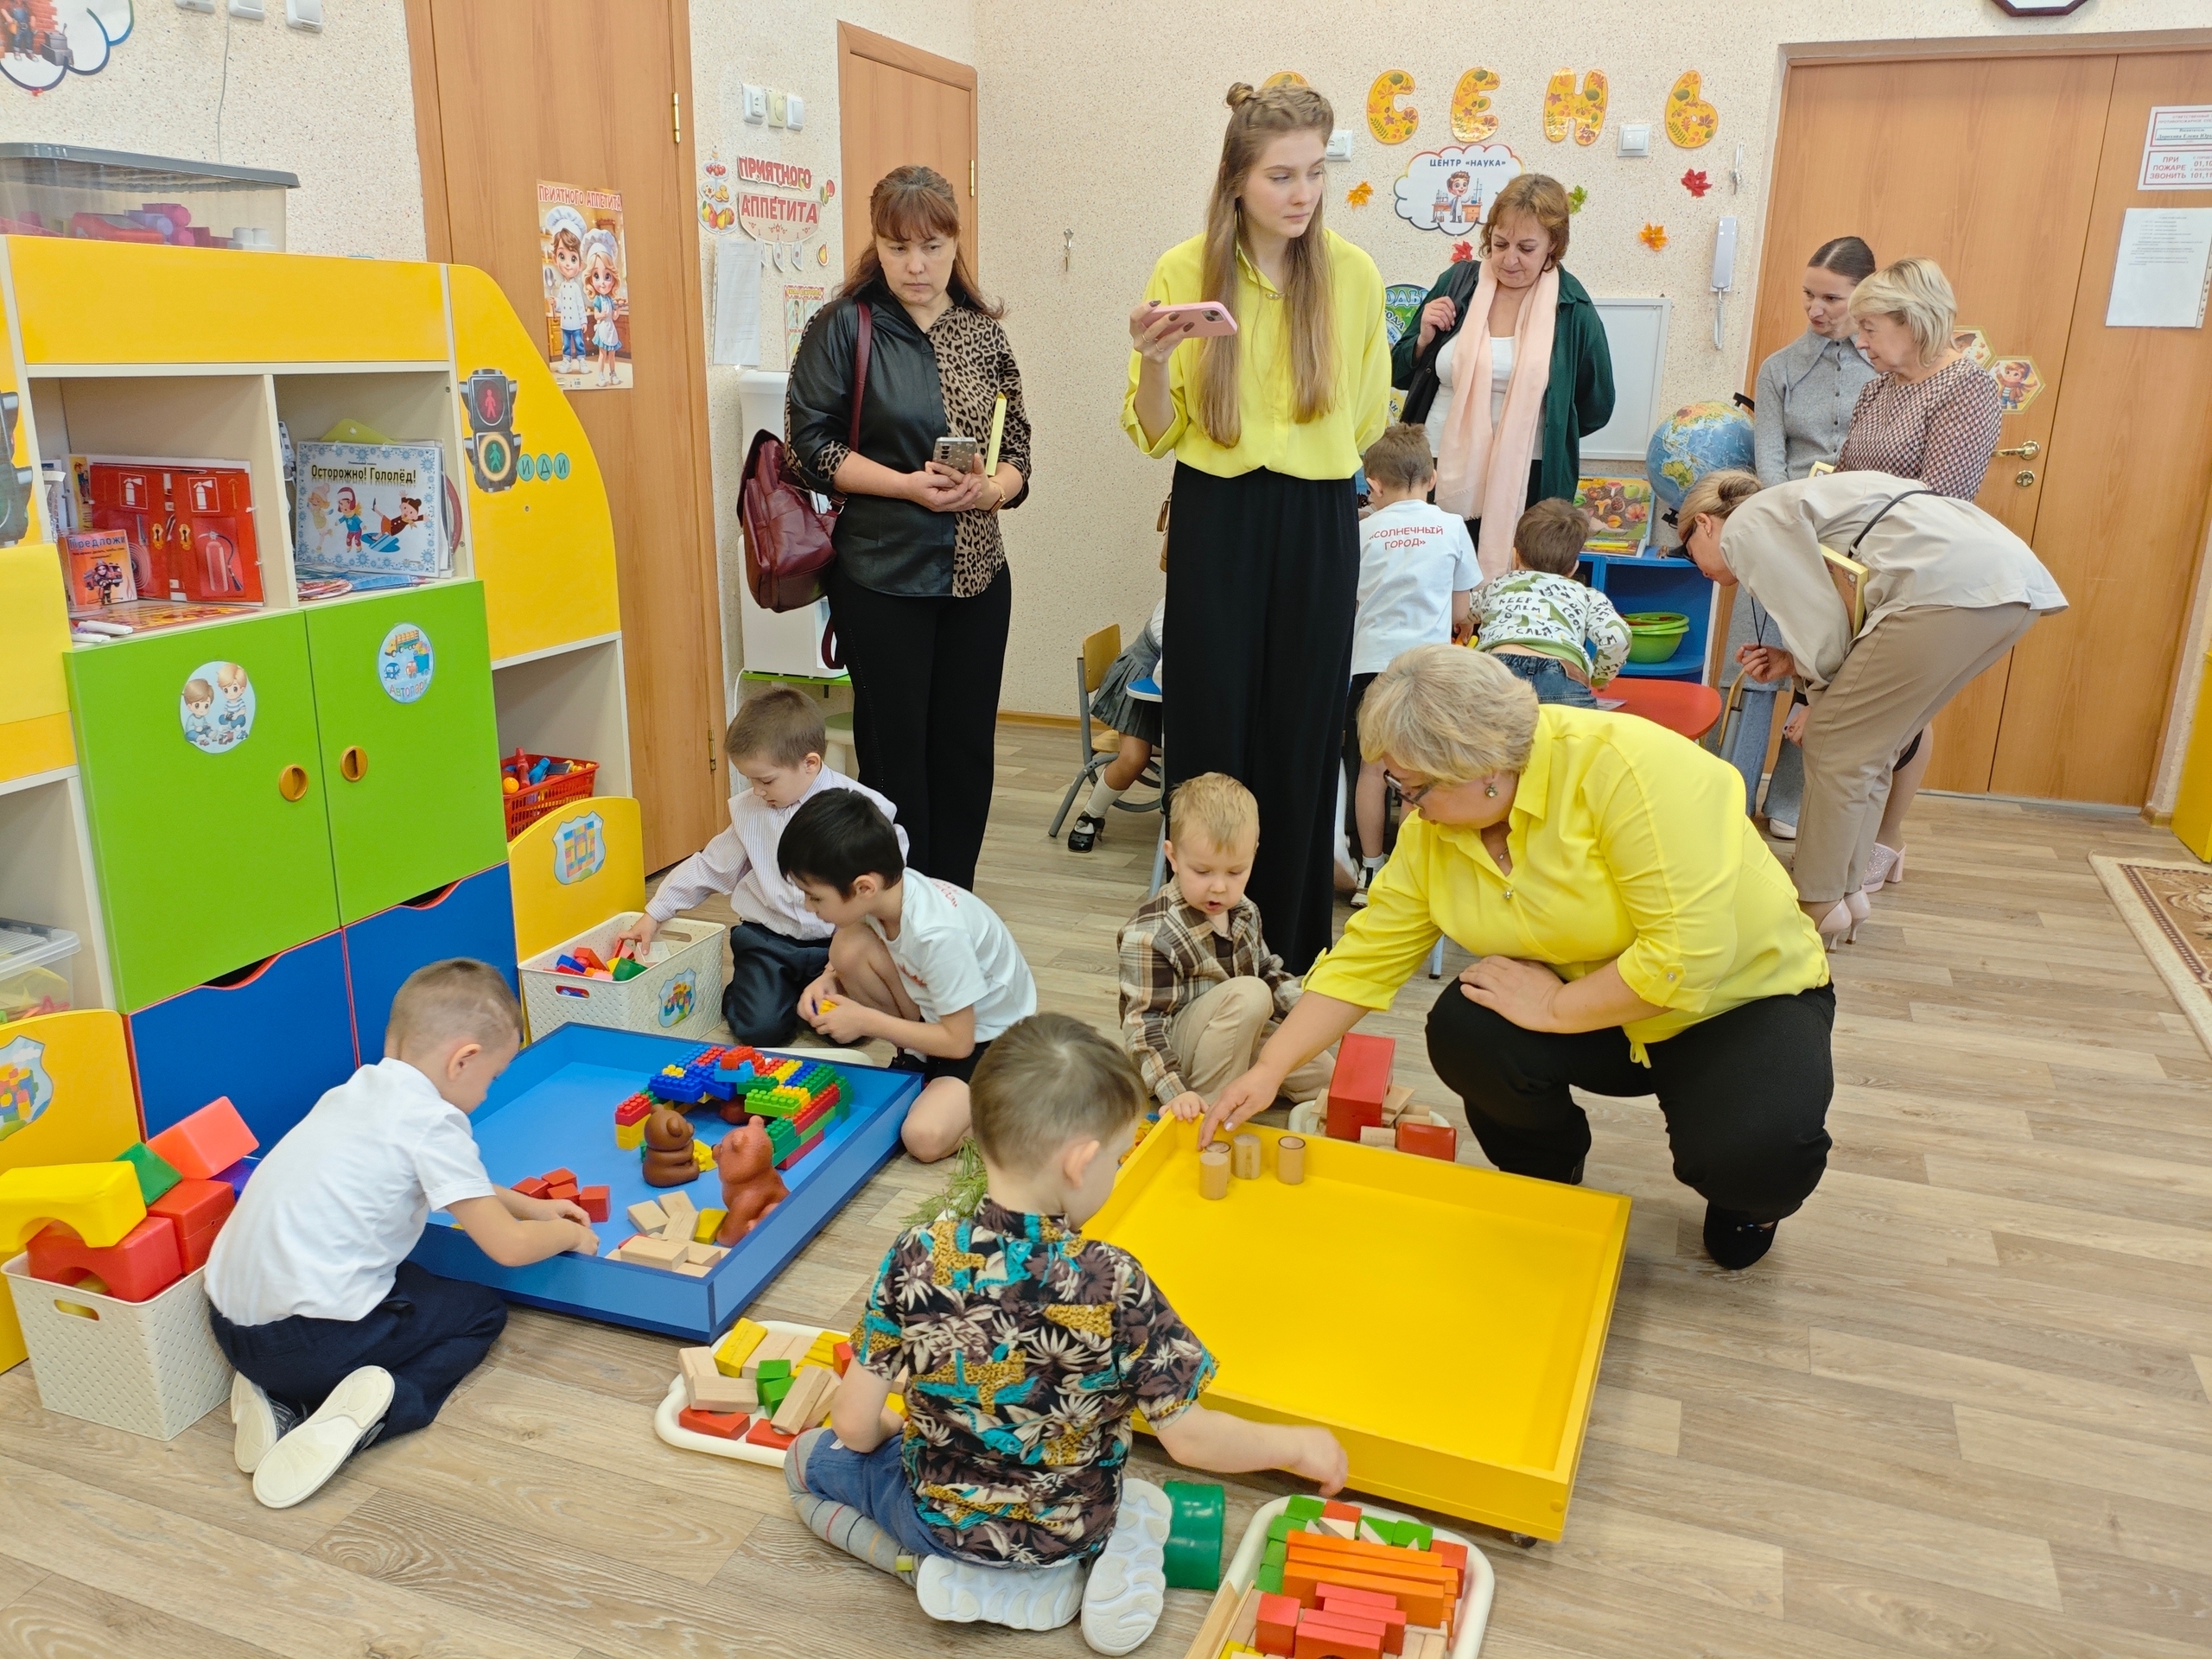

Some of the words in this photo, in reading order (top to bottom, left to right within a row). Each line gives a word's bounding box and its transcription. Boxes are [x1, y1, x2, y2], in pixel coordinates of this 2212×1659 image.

[1430, 159, 1461, 168] ЦЕНТР
[739, 156, 811, 189] ПРИЯТНОГО
[538, 185, 584, 205] ПРИЯТНОГО
[587, 191, 622, 210] АППЕТИТА
[741, 194, 817, 224] АППЕТИТА
[312, 465, 367, 481] Осторожно!
[370, 467, 416, 485] Гололёд!
[522, 459, 567, 476] ИДИ
[1369, 525, 1443, 540] «СОЛНЕЧНЫЙ
[69, 536, 126, 550] Предложи
[1384, 537, 1426, 550] ГОРОД»
